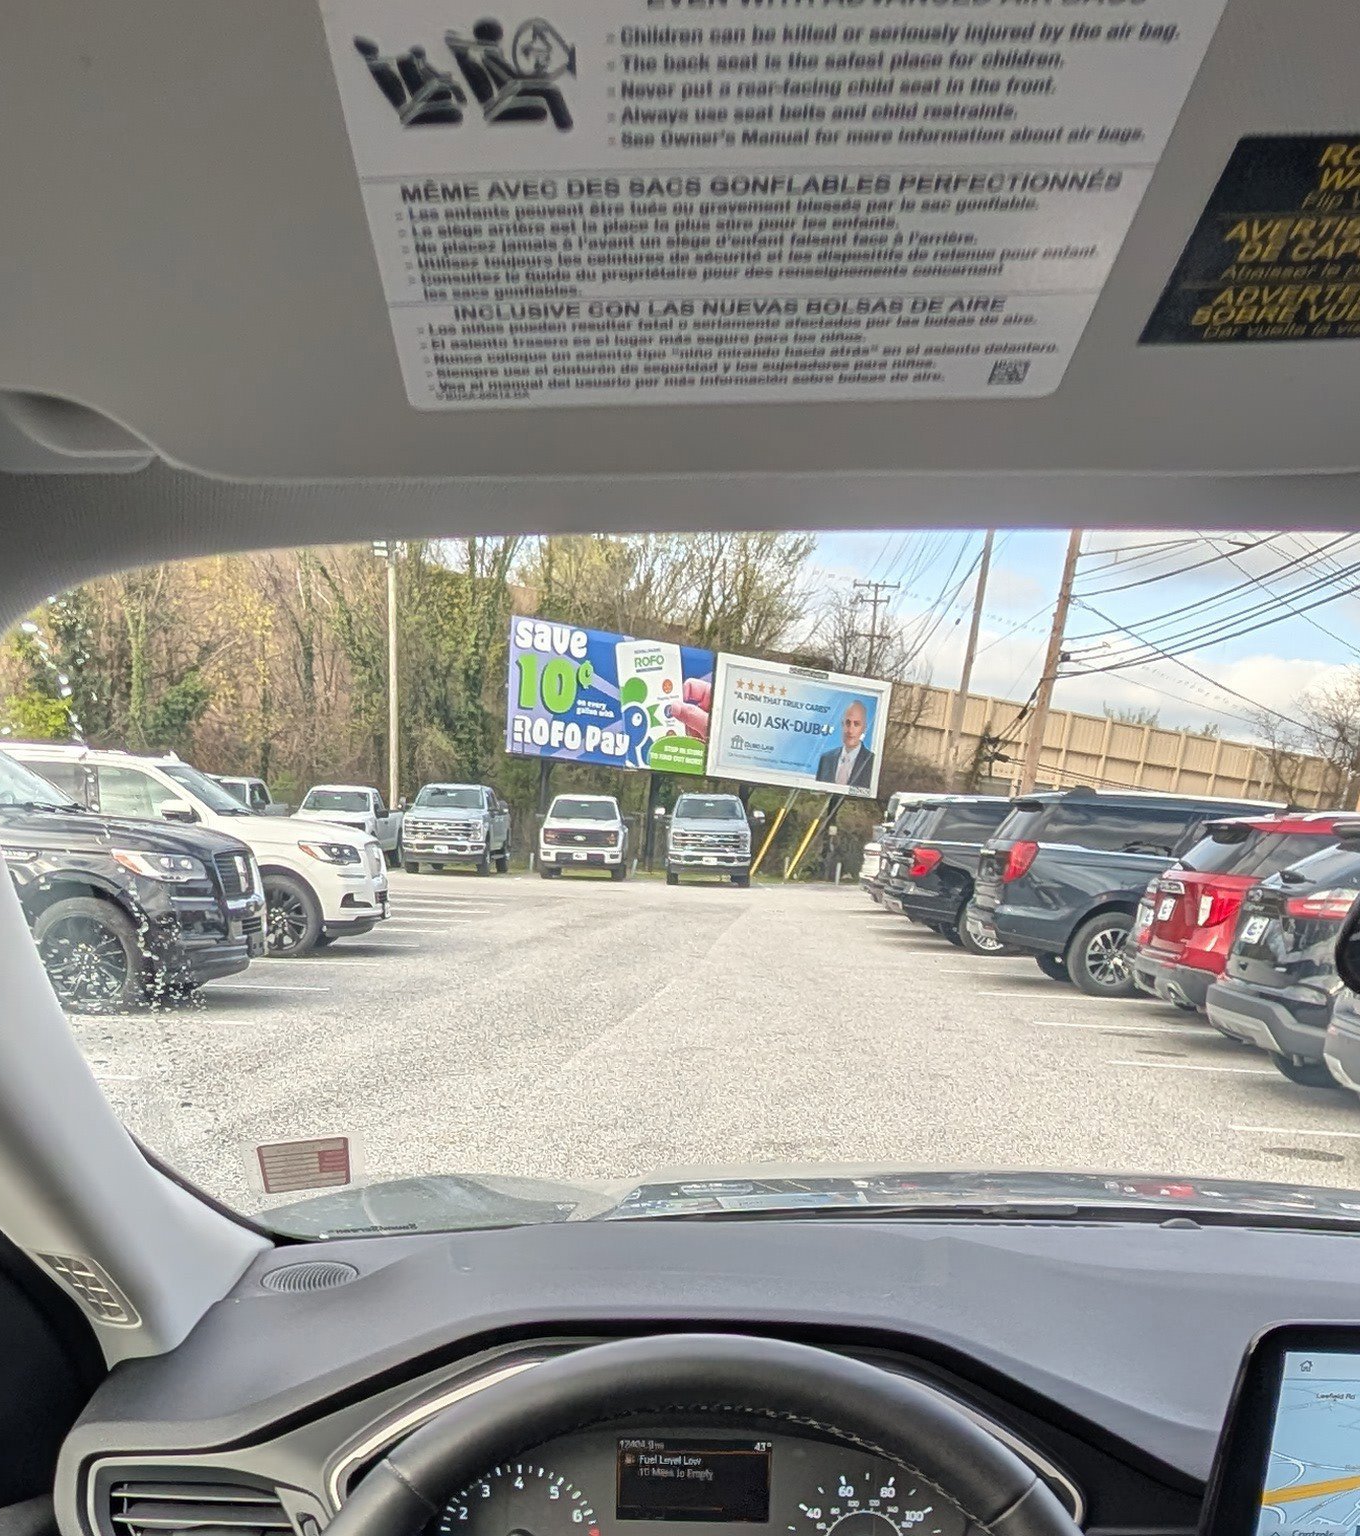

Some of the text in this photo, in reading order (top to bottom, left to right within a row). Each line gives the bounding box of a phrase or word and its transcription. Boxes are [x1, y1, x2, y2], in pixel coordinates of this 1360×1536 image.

[621, 20, 1179, 46] Children can be killed or seriously injured by the air bag.
[622, 50, 1064, 73] The back seat is the safest place for children.
[400, 179, 480, 204] MÊME
[488, 179, 558, 200] AVEC
[567, 178, 620, 199] DES
[710, 174, 890, 197] GONFLABLES
[899, 168, 1122, 194] PERFECTIONNÉS
[454, 296, 1008, 321] INCLUSIVE CON LAS NUEVAS BOLSAS DE AIRE
[1192, 304, 1296, 327] SOBRE
[634, 655, 664, 668] ROFO
[744, 692, 762, 702] FIRM
[763, 696, 782, 705] THAT
[783, 699, 804, 709] TRULY
[733, 708, 762, 728] (410)
[513, 715, 582, 750] ROFO
[640, 1455, 701, 1466] Fuel Level Low
[514, 1476, 524, 1489] 4
[481, 1484, 490, 1498] 3
[549, 1486, 559, 1500] 5
[838, 1486, 854, 1497] 60
[880, 1487, 896, 1498] 80
[459, 1507, 468, 1520] 2
[572, 1509, 583, 1522] 6
[806, 1508, 822, 1519] 40
[905, 1511, 924, 1522] 100
